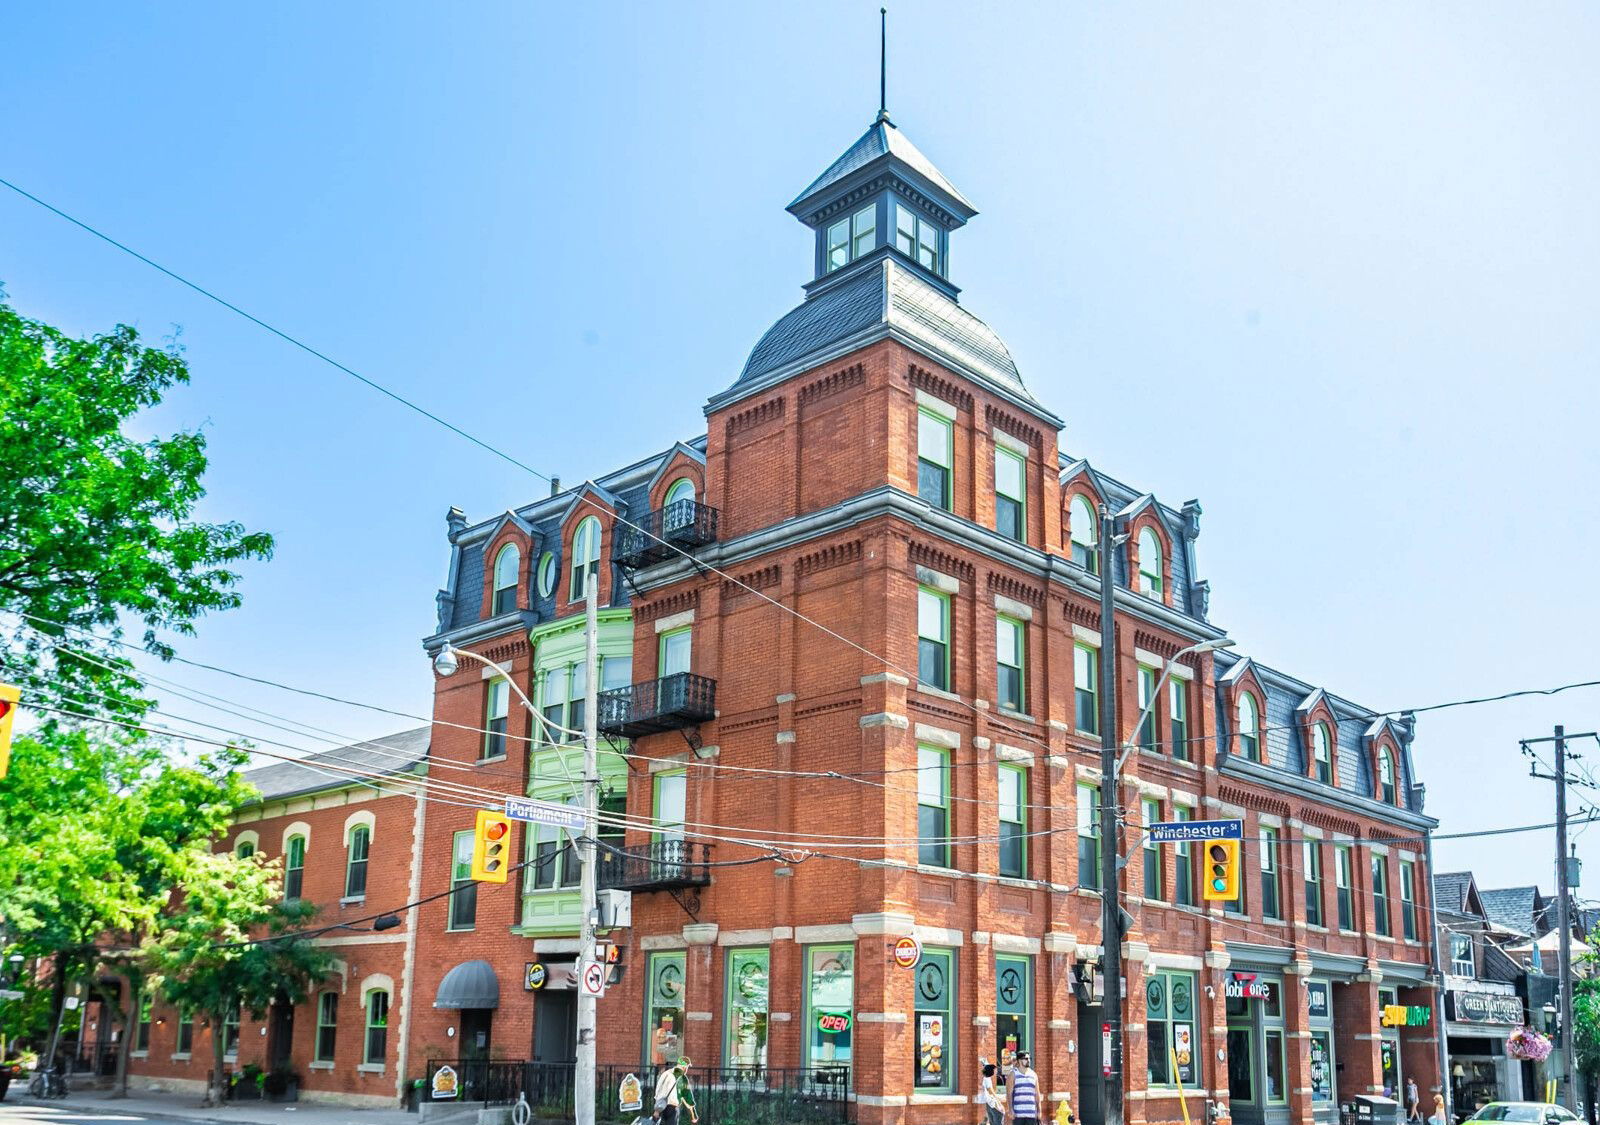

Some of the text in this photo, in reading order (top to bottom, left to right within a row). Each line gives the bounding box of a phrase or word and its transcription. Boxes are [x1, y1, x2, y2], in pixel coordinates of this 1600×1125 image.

[510, 801, 572, 825] Parliament
[1153, 823, 1237, 840] Winchester St
[821, 1015, 848, 1031] OPEN
[1382, 1005, 1430, 1026] SUBWAY
